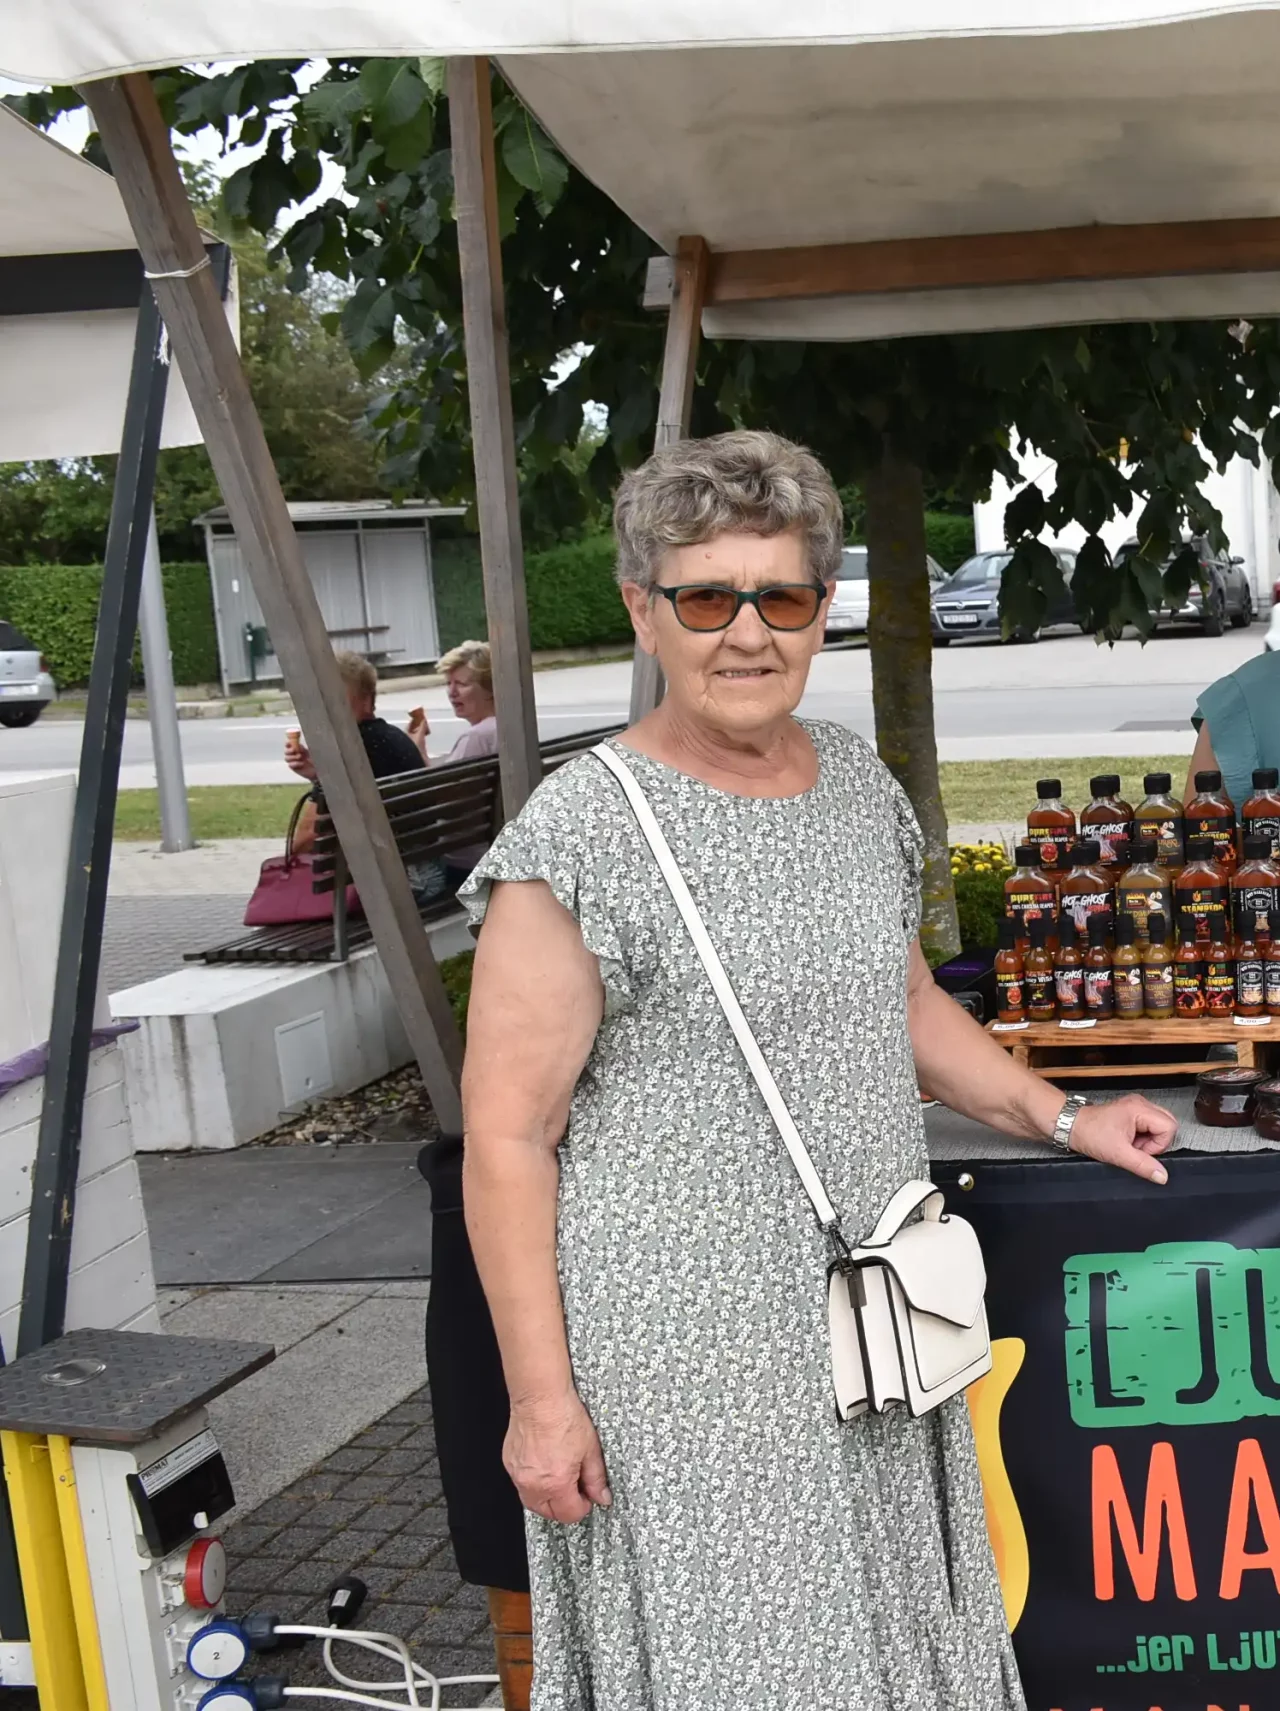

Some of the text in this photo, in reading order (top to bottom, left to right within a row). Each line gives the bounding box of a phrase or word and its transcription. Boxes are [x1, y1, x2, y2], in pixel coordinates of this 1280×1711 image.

[1100, 822, 1128, 835] GHOST
[1080, 892, 1110, 906] GHOST
[213, 1651, 220, 1660] 2
